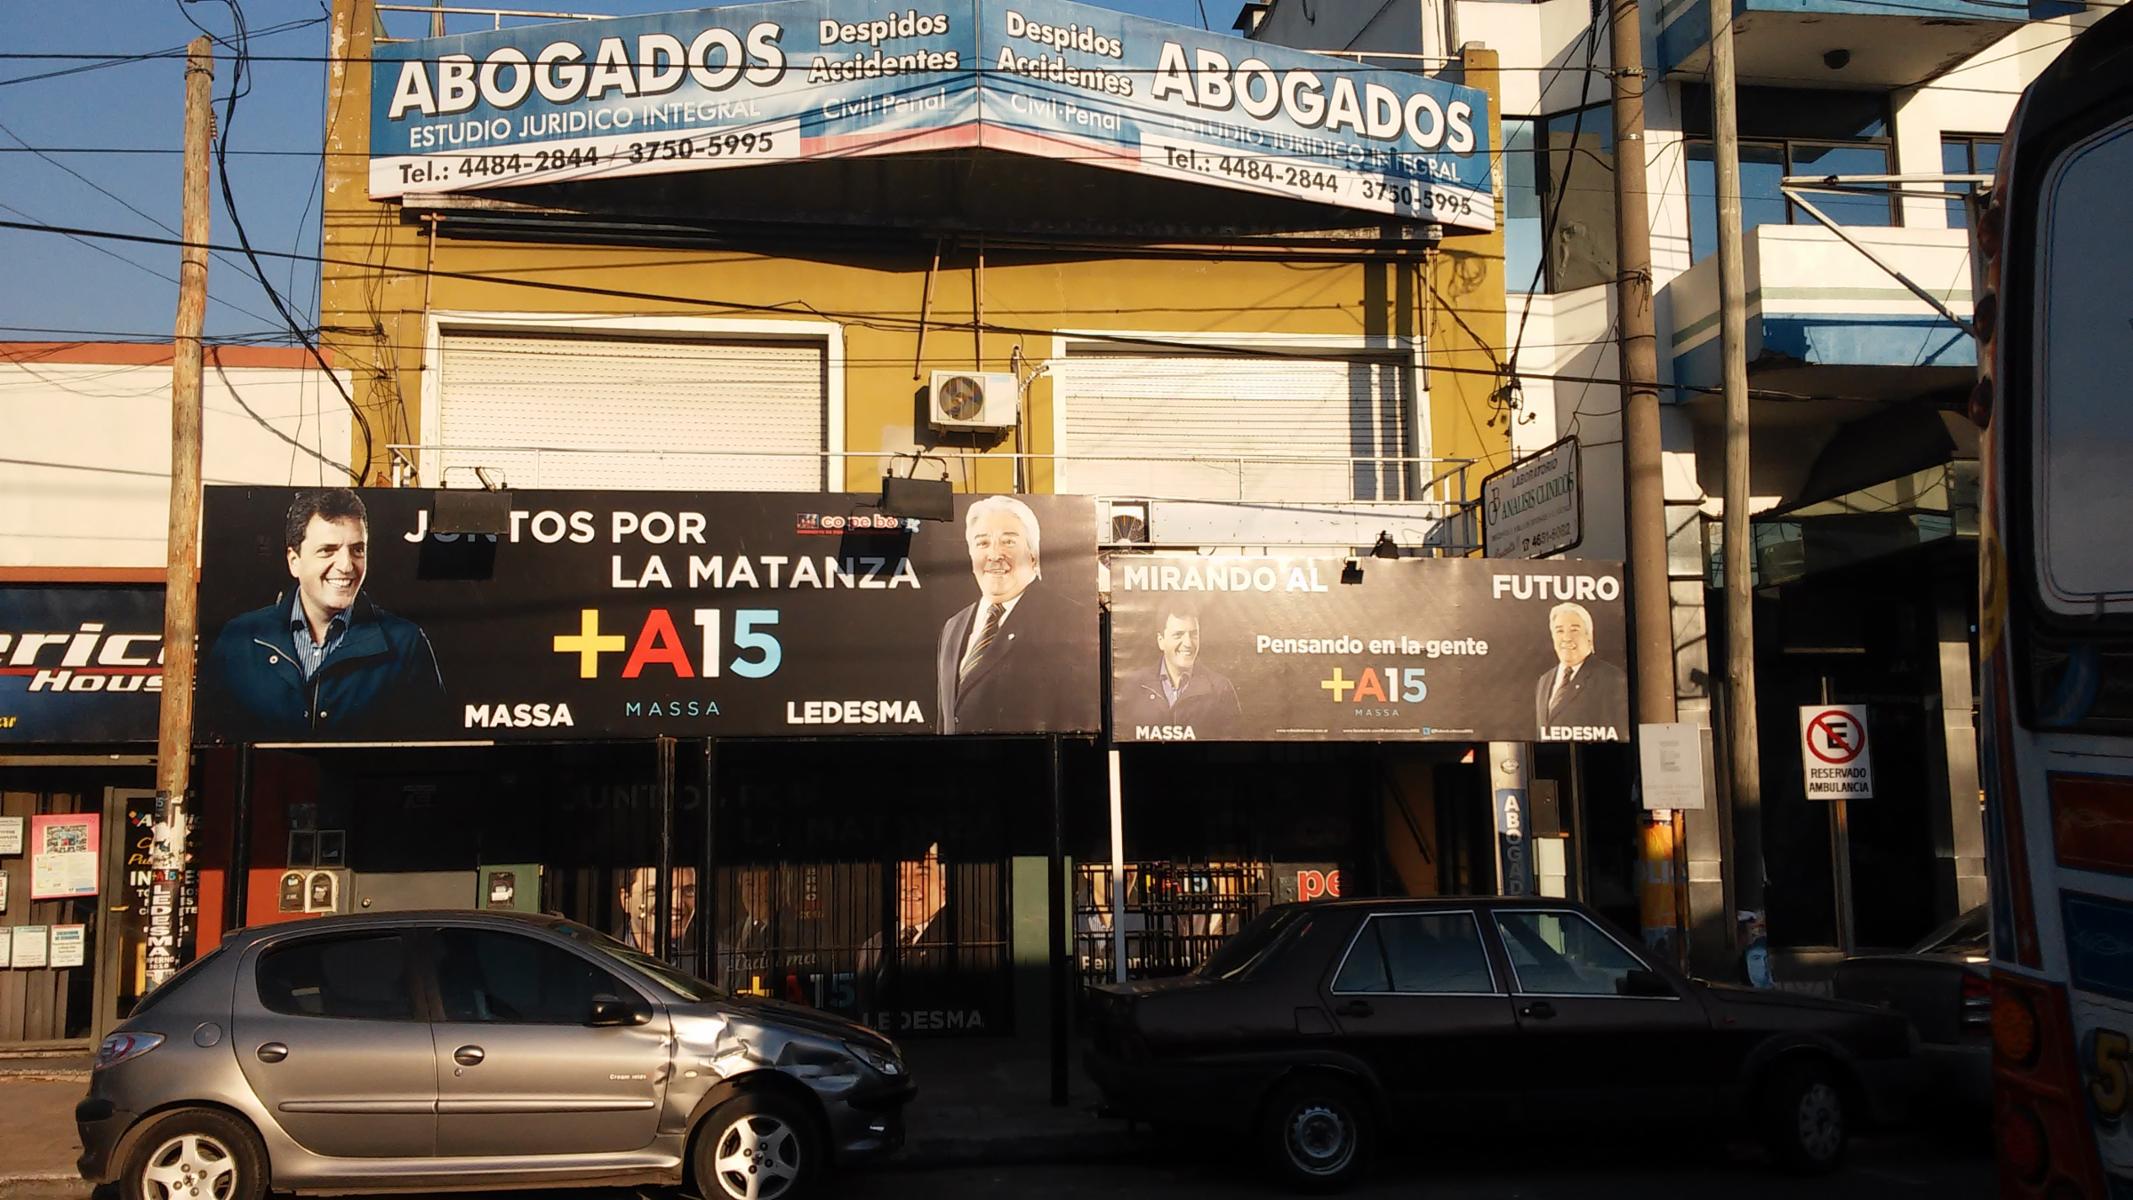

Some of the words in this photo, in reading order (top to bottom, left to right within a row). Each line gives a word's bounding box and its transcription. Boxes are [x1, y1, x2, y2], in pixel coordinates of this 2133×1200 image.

[819, 10, 948, 46] Despidos
[1005, 10, 1123, 57] Despidos
[388, 22, 787, 121] ABOGADOS
[807, 50, 959, 83] Accidentes
[997, 46, 1133, 96] Accidentes
[1151, 41, 1476, 155] ABOGADOS
[410, 118, 511, 149] ESTUDIO
[517, 107, 634, 143] JURIDICO
[643, 96, 762, 126] INTEGRAL
[400, 160, 450, 185] Tel.:
[458, 144, 600, 178] 4484-2844
[629, 131, 774, 164] 3750-5995
[1173, 116, 1264, 147] ESTUDIO
[1271, 129, 1367, 166] JURIDICO
[1371, 147, 1462, 184] INTEGRAL
[1163, 145, 1211, 173] Tel.:
[1218, 155, 1339, 193] 4484-2844
[1362, 180, 1473, 216] 3750-5995
[404, 510, 596, 544] JTOS
[611, 510, 707, 545] POR
[611, 555, 672, 590] LA
[687, 555, 921, 590] MATANZA
[1123, 566, 1277, 593] MIRANDO
[1285, 566, 1329, 593] AL
[1492, 574, 1620, 602] FUTURO
[0, 623, 198, 668] ric
[553, 608, 783, 680] +A15
[1255, 635, 1364, 656] Pensando
[1368, 638, 1396, 655] en
[1400, 635, 1421, 655] la
[1425, 638, 1489, 659] gente
[28, 669, 197, 692] Hous
[1320, 666, 1428, 703] +A15
[465, 704, 574, 729] MASSA
[625, 701, 720, 718] MASSA
[786, 700, 924, 725] LEDESMA
[1354, 708, 1400, 718] MASSA
[1135, 725, 1196, 741] MASSA
[1540, 725, 1619, 741] LEDESMA
[1809, 782, 1870, 793] AMBULANCIA
[1810, 767, 1867, 779] RESERVADO
[147, 884, 173, 957] LEDESMA
[862, 1009, 985, 1031] LEDESMA
